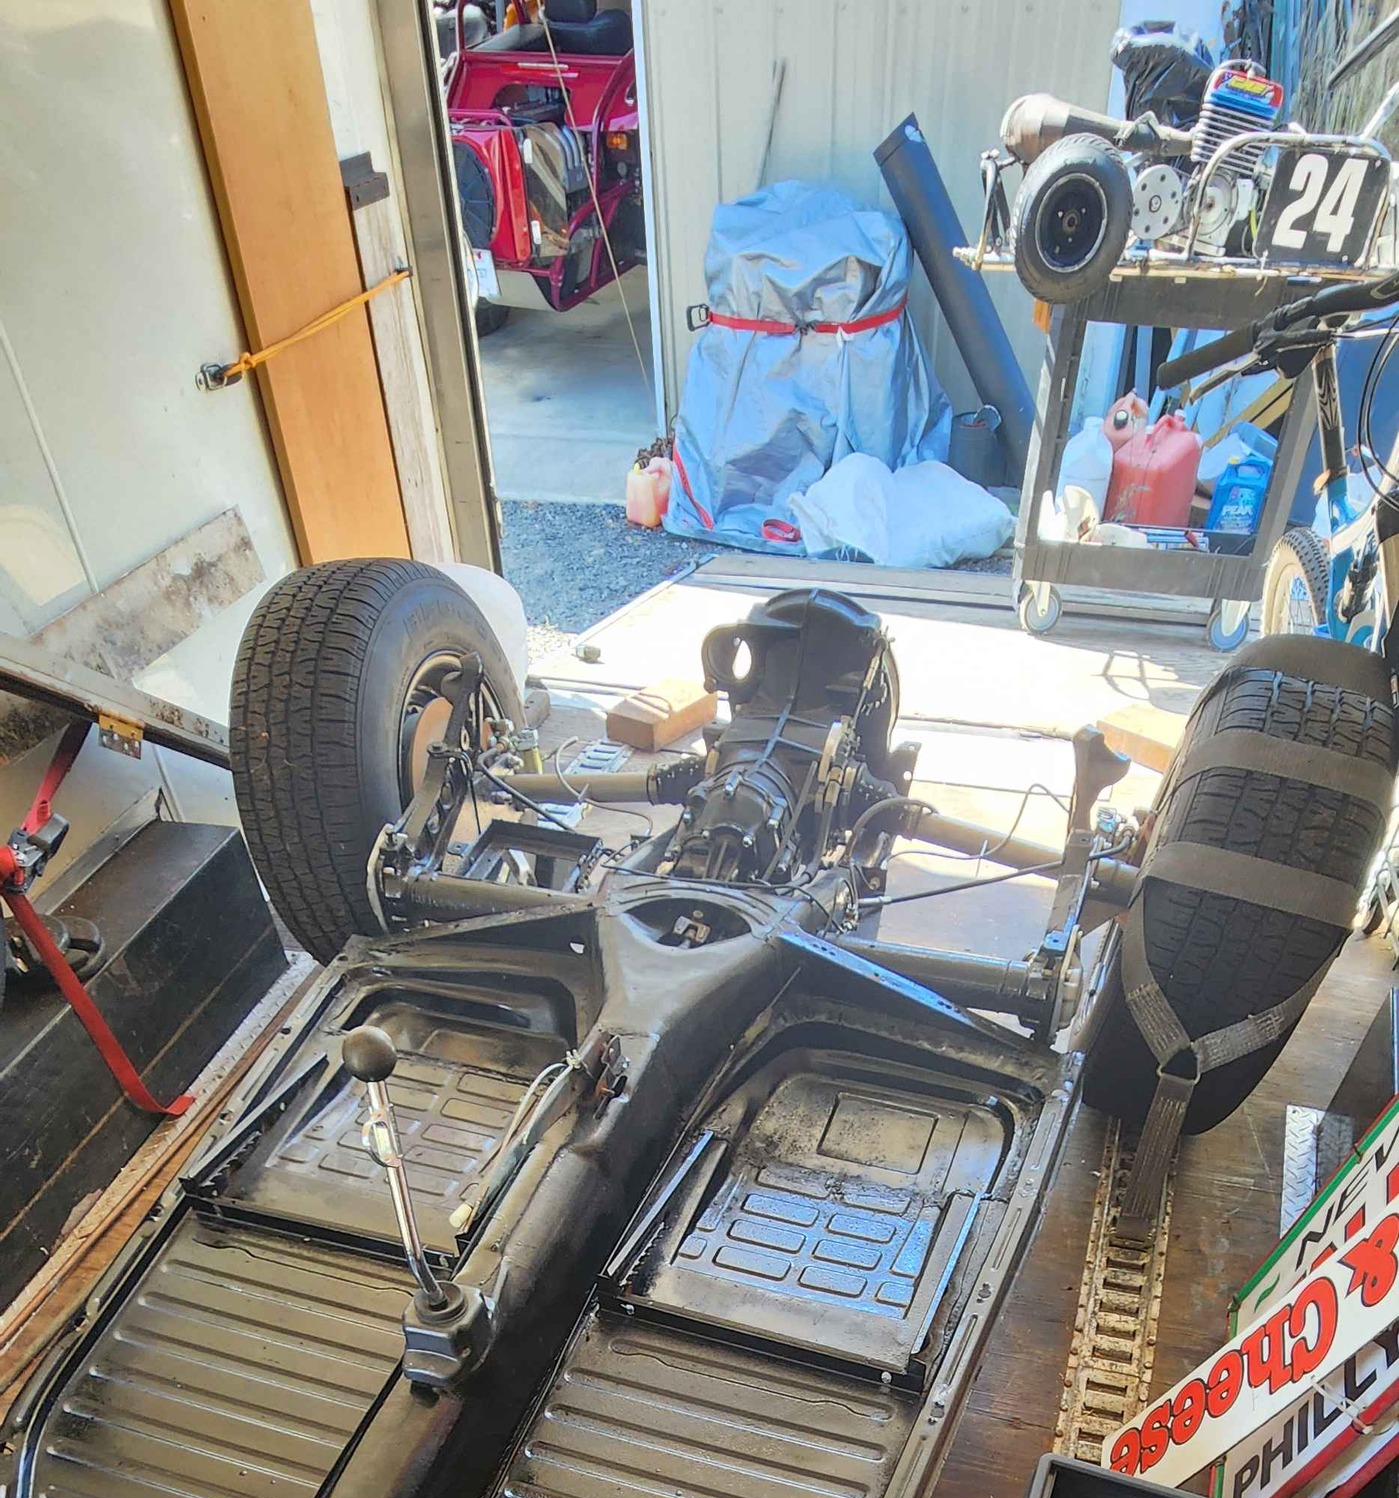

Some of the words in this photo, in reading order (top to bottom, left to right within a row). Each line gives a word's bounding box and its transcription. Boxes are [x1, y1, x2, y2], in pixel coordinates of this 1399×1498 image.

[1272, 153, 1369, 253] 24
[1337, 1212, 1399, 1308] &
[1109, 1276, 1338, 1478] Cheese
